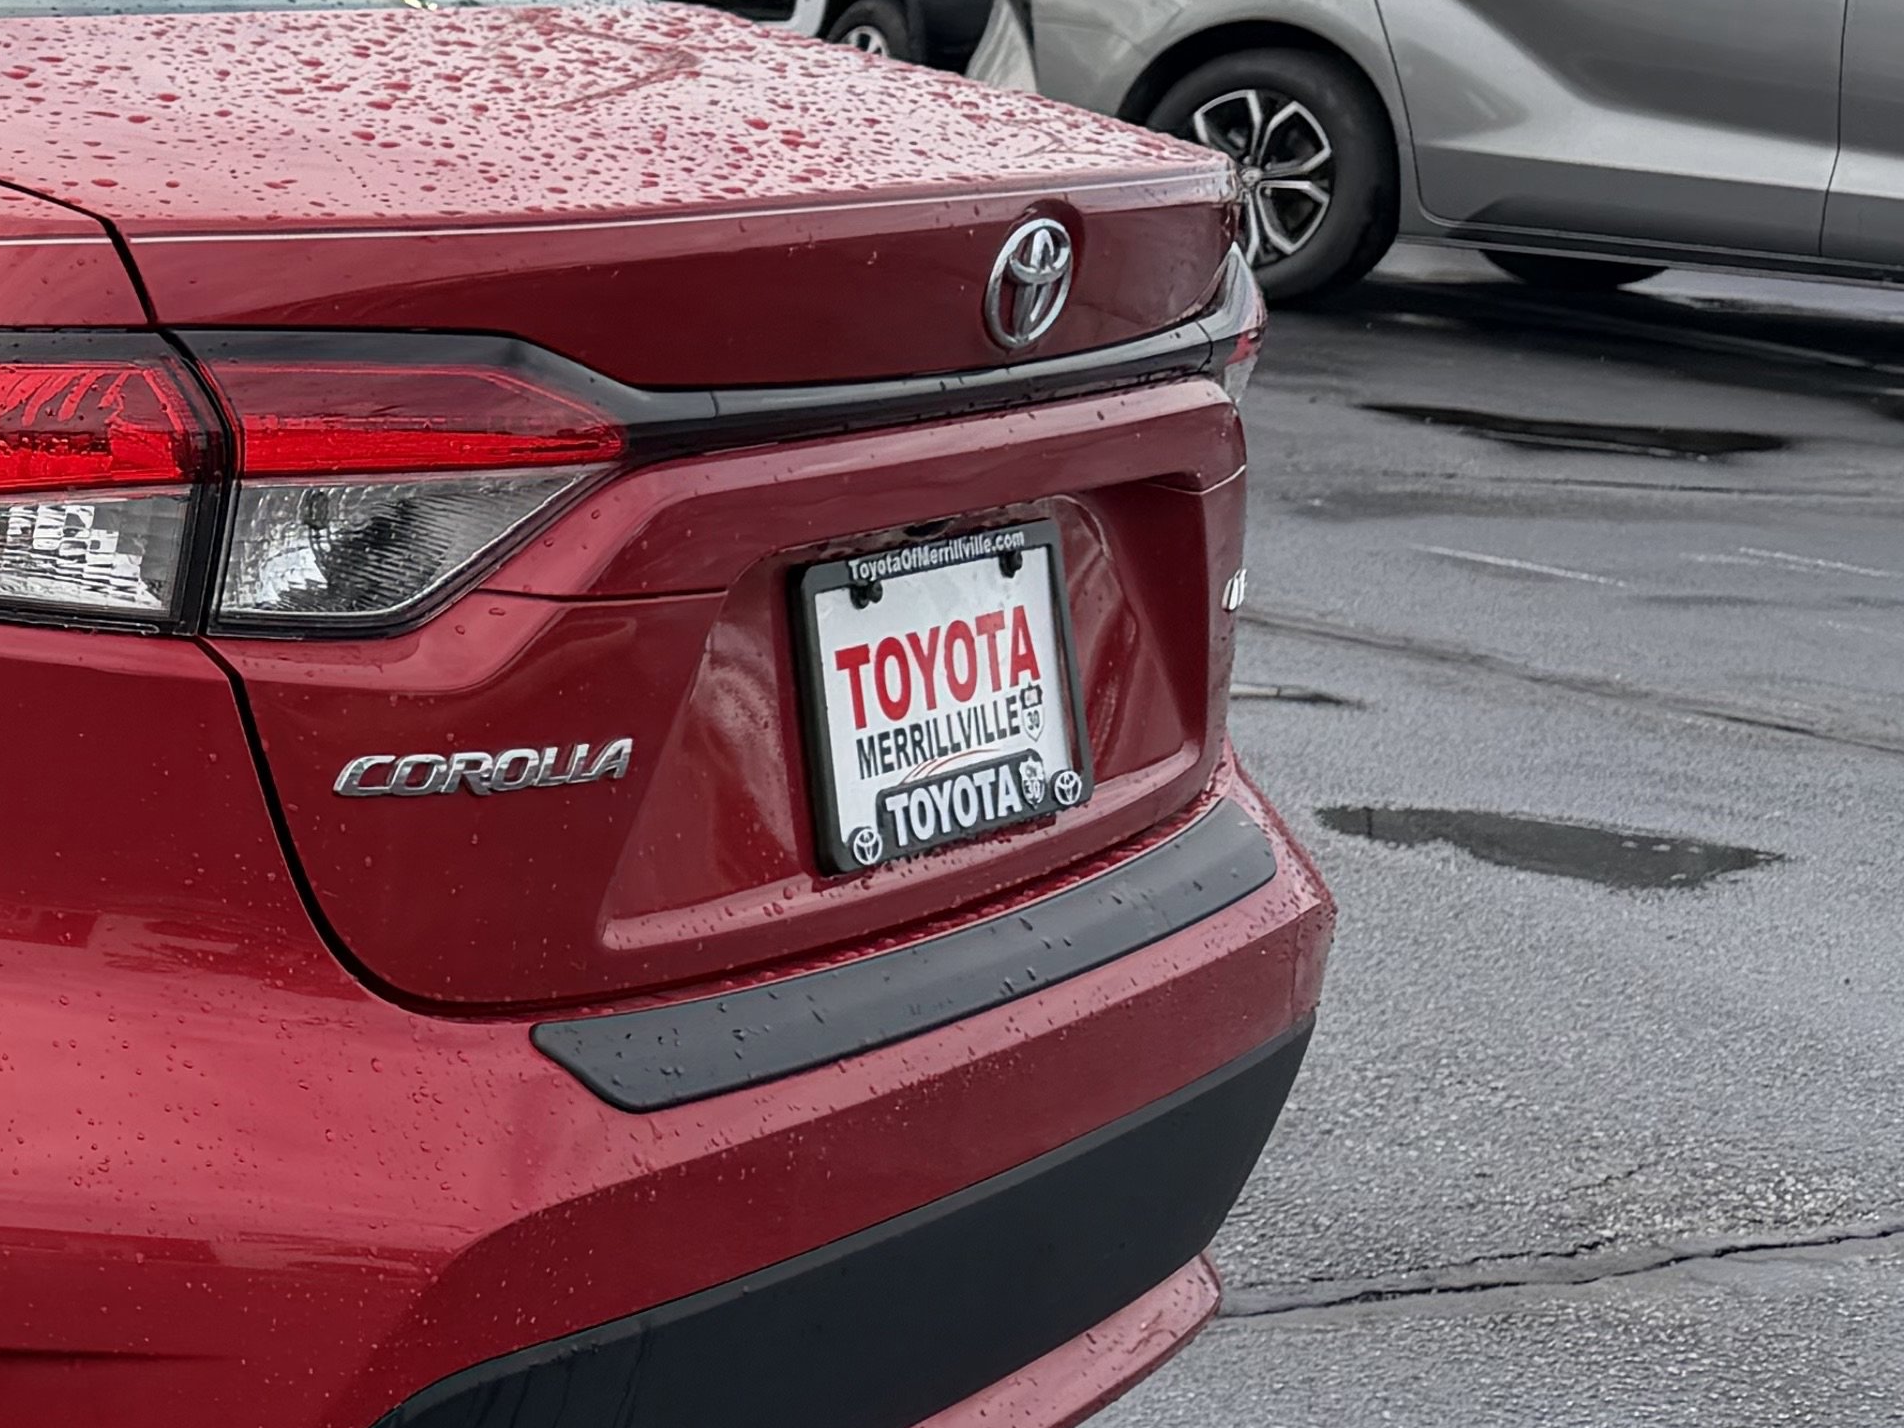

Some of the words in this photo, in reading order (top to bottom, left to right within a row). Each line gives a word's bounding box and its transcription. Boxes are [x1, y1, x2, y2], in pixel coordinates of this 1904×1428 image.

[848, 530, 1025, 581] ToyotaOfMerrillville.com
[835, 605, 1041, 730] TOYOTA
[333, 737, 634, 797] COROLLA
[856, 695, 1021, 780] MERRILLVILLE
[886, 763, 1023, 847] TOYOTA
